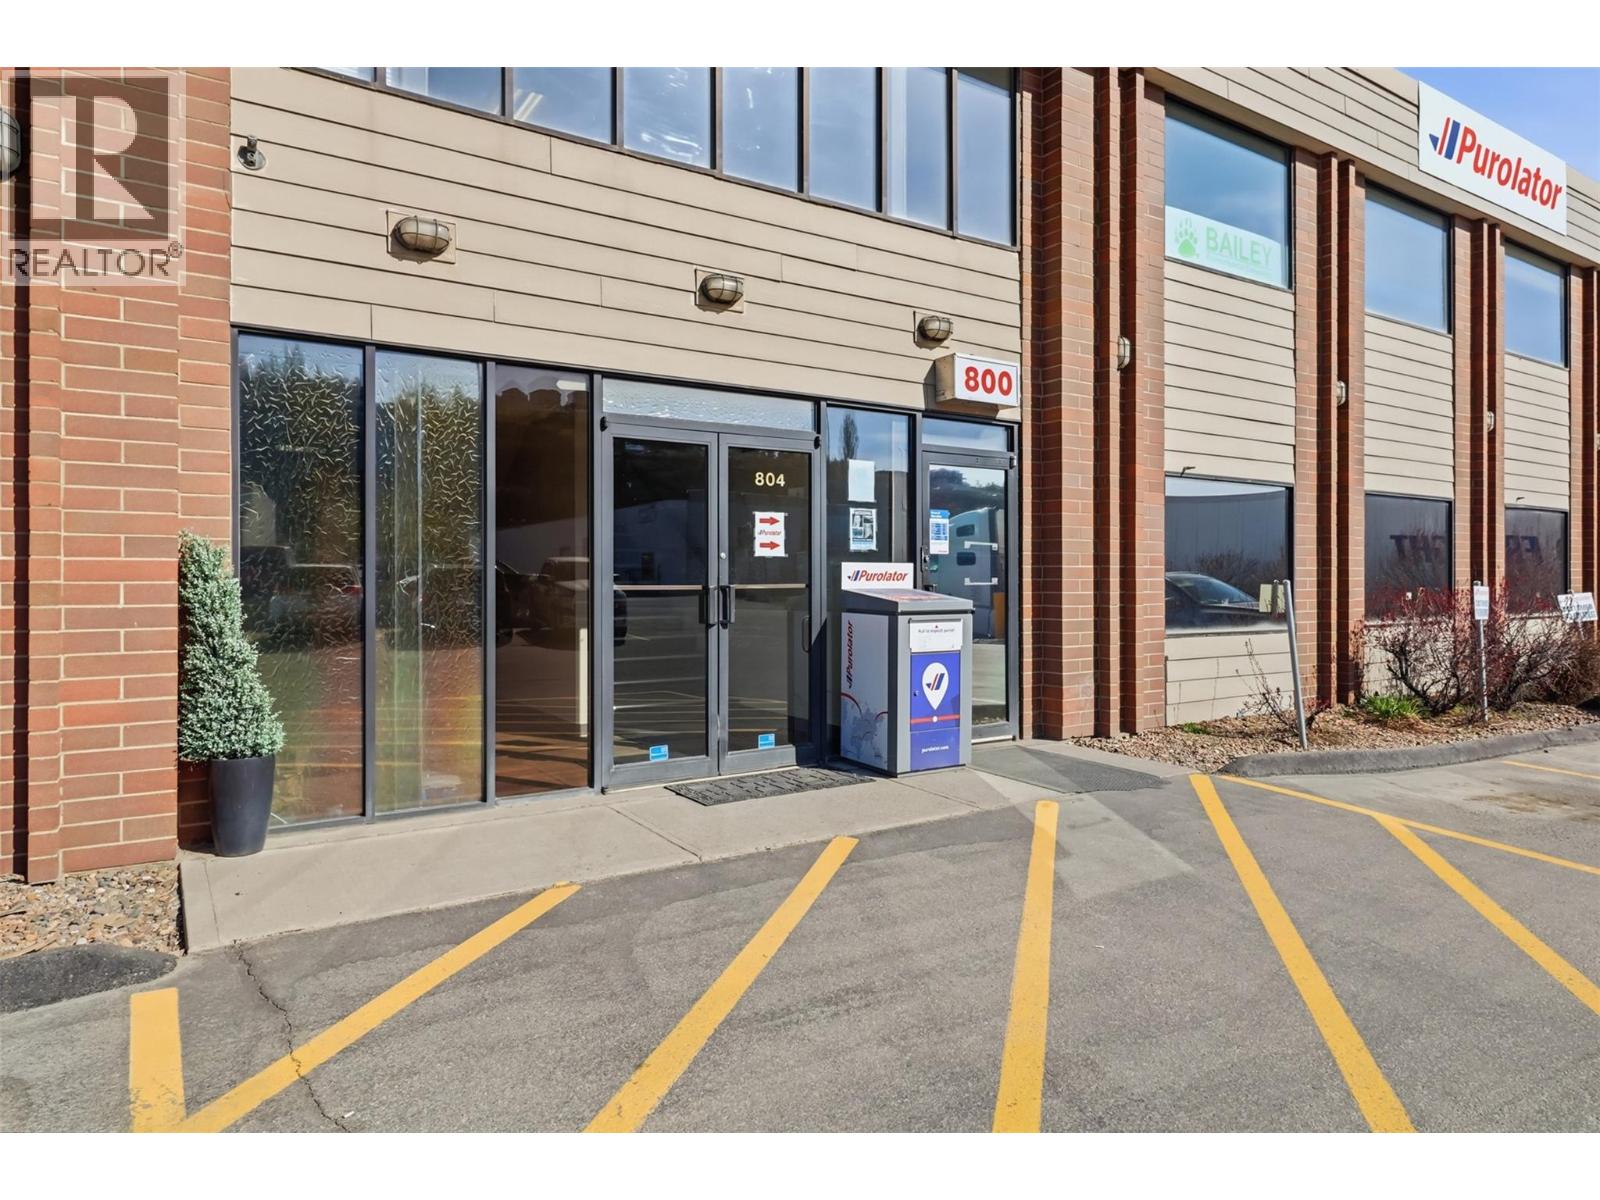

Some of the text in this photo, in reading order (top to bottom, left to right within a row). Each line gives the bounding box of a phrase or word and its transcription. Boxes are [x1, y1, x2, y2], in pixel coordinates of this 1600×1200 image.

[1456, 126, 1563, 210] Purolator
[1206, 226, 1272, 268] BAILEY
[964, 366, 1013, 397] 800
[754, 471, 786, 487] 804
[858, 569, 909, 582] Purolator
[846, 619, 854, 677] Purolator
